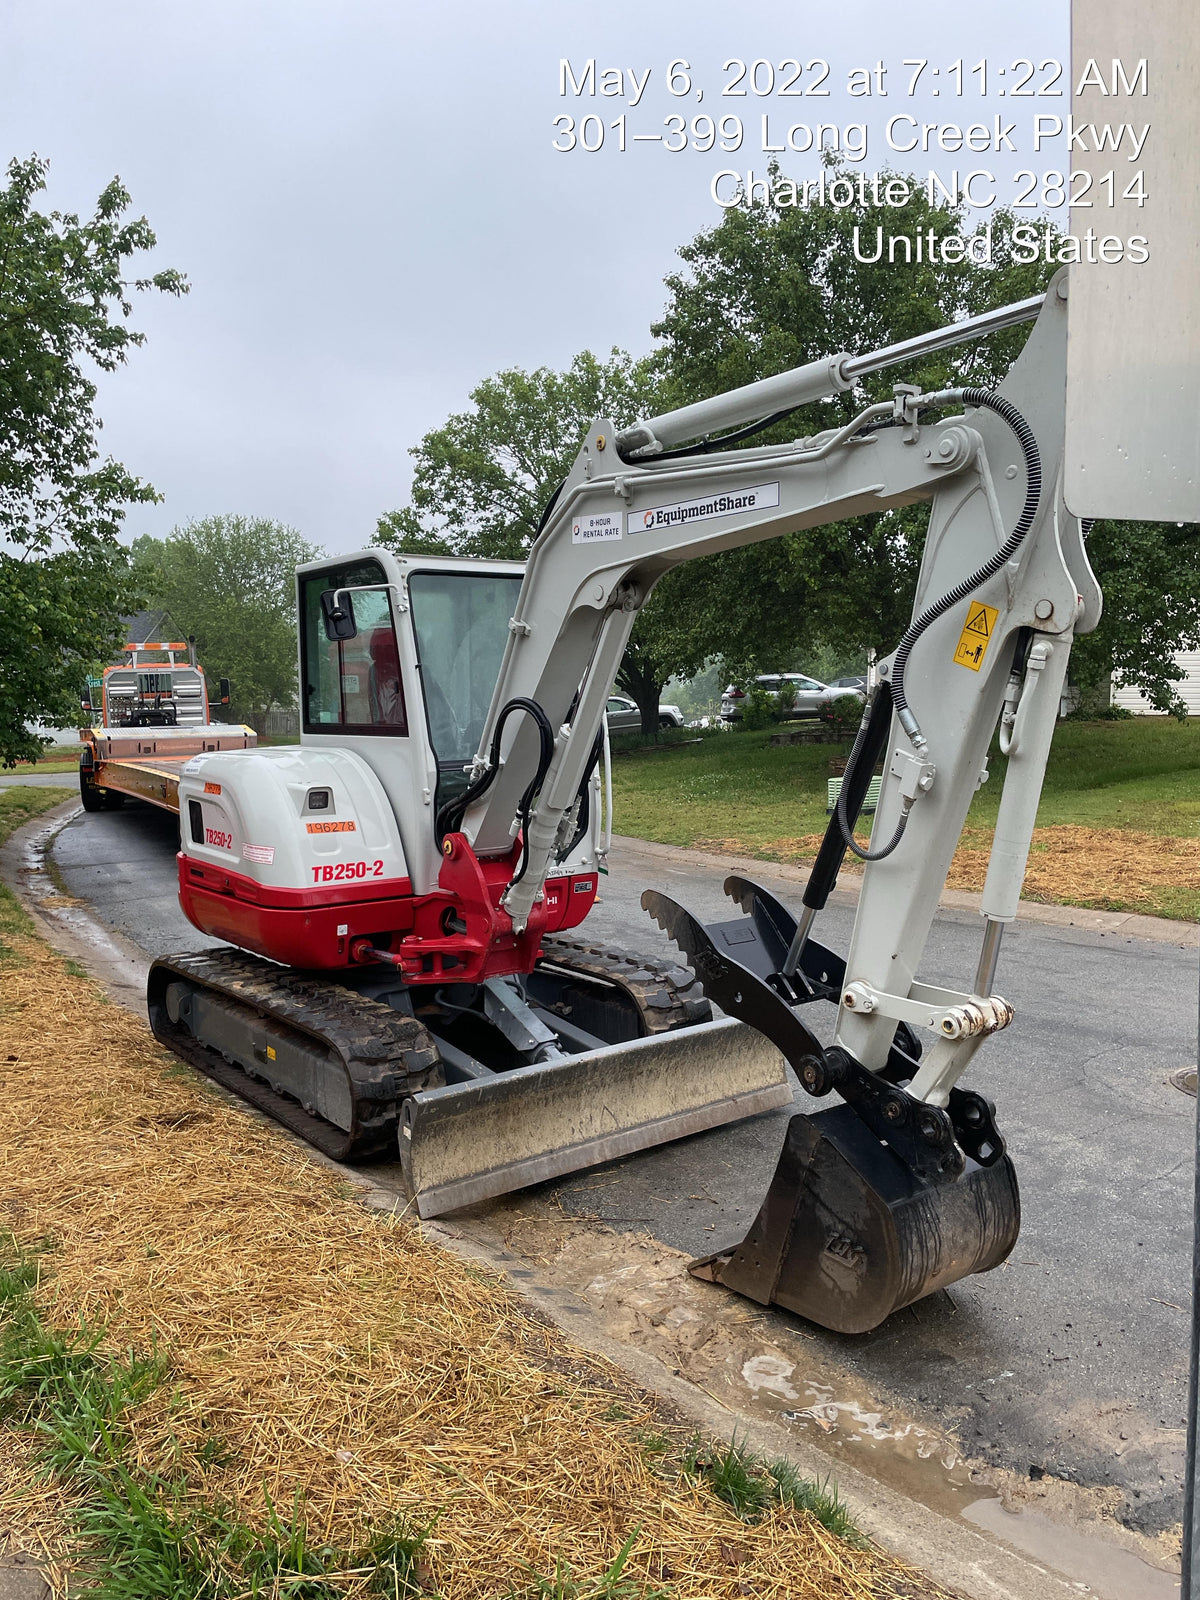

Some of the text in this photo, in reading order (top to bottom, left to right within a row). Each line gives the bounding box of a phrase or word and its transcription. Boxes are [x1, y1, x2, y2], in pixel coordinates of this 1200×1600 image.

[656, 493, 756, 526] EquipmentShare
[583, 527, 619, 538] RENTAL RATE
[308, 821, 356, 833] 196278
[205, 828, 231, 849] TB250-2
[312, 860, 384, 882] TB250-2
